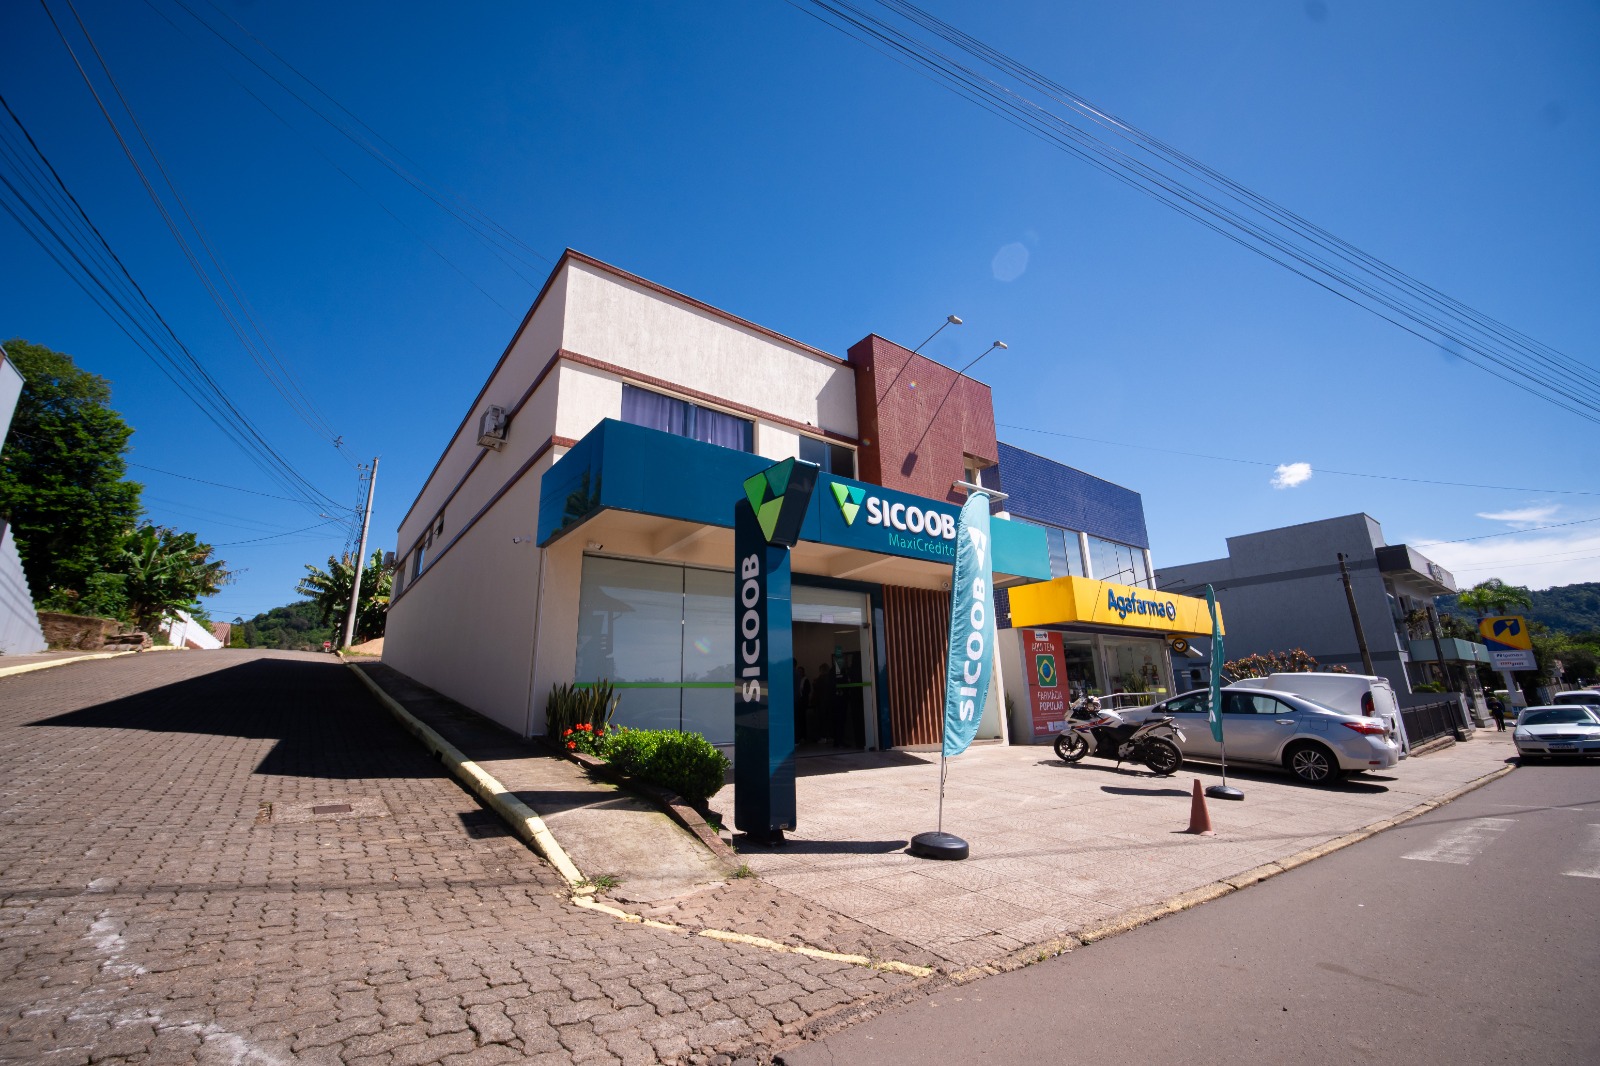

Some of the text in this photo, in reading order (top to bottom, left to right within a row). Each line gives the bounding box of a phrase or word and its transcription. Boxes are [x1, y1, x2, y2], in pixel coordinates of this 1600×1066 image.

[866, 496, 956, 540] SICOOB
[888, 532, 955, 557] MaxiCrédito
[1108, 588, 1166, 619] Agafarma
[741, 553, 760, 703] SICOOB
[959, 577, 986, 722] SICOOB
[1039, 701, 1064, 711] POPULAR
